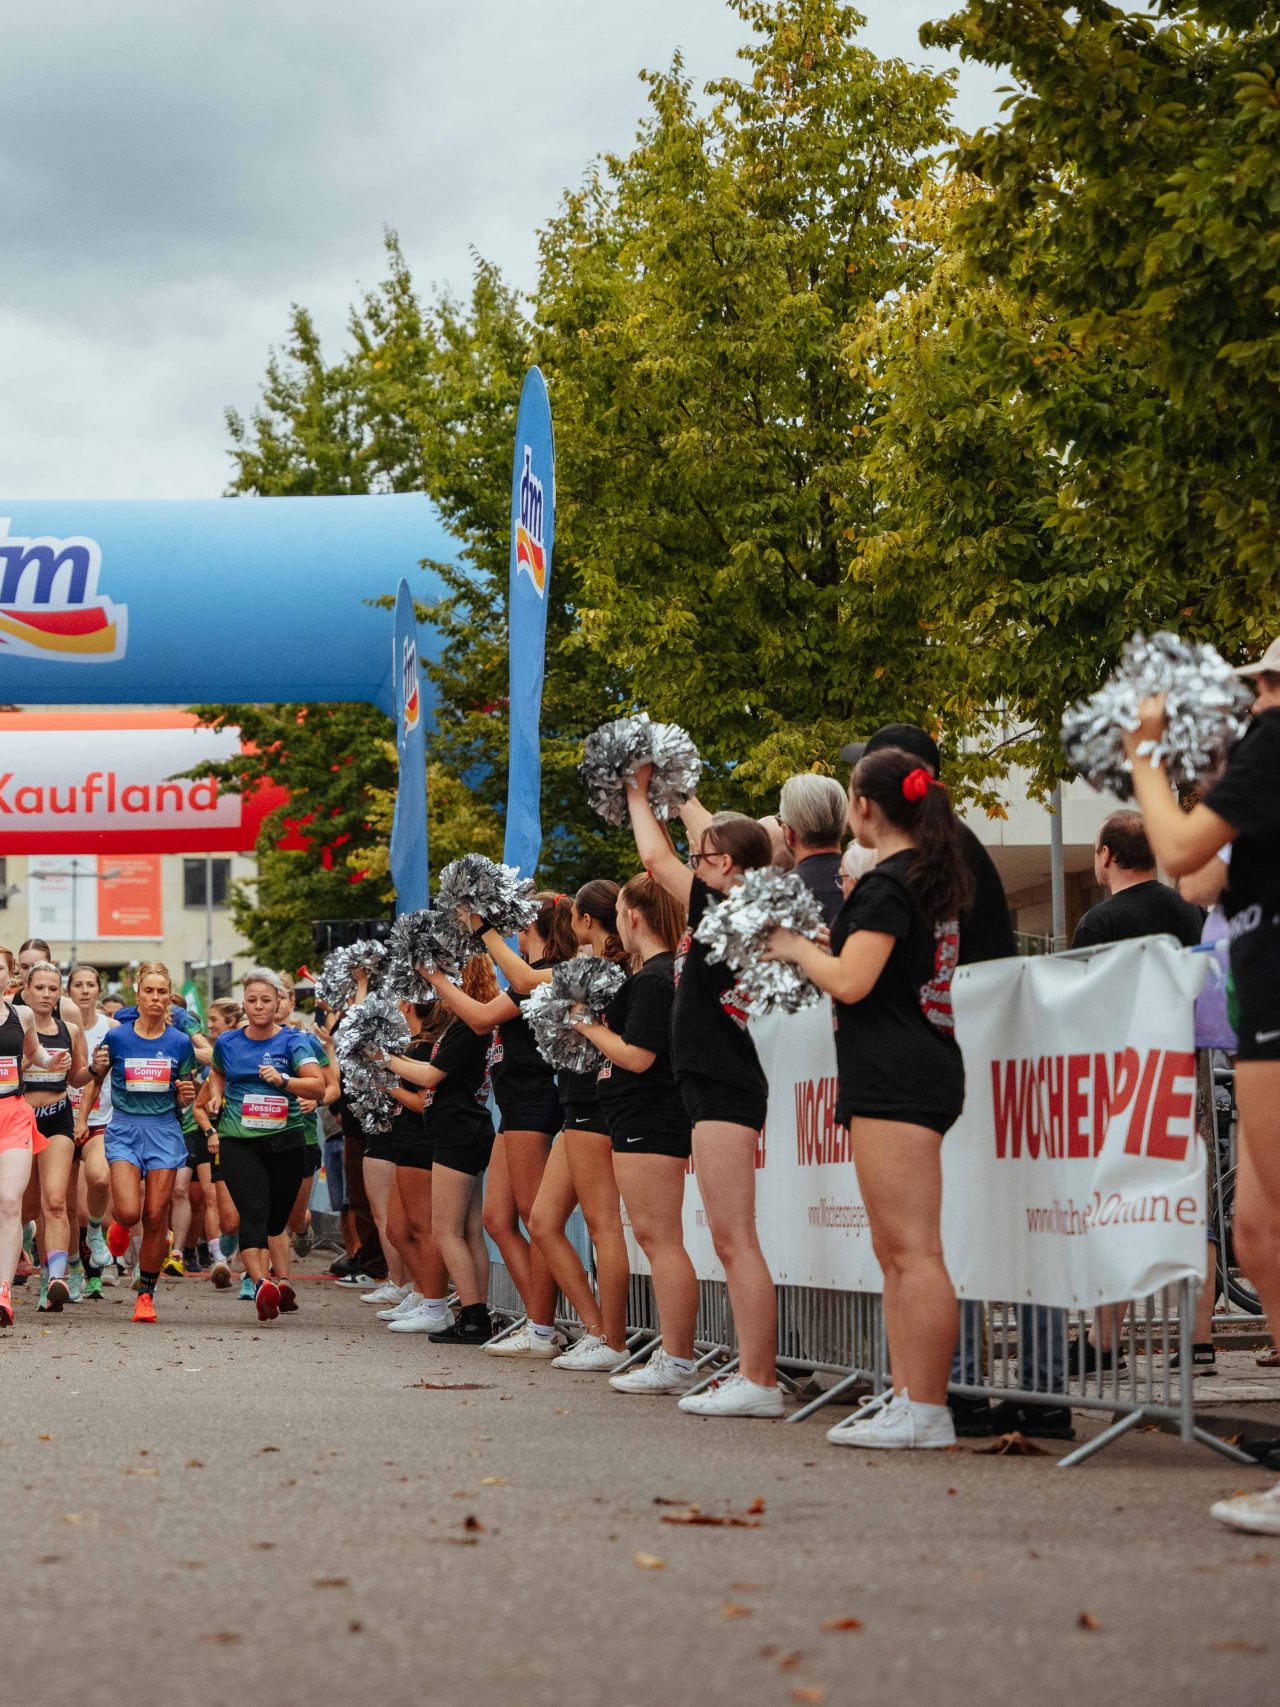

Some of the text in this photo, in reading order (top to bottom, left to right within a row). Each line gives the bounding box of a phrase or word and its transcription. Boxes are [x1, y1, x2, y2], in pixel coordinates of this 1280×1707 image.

[522, 454, 542, 543] dm
[134, 1067, 162, 1077] Conny
[249, 1103, 282, 1113] Jessica
